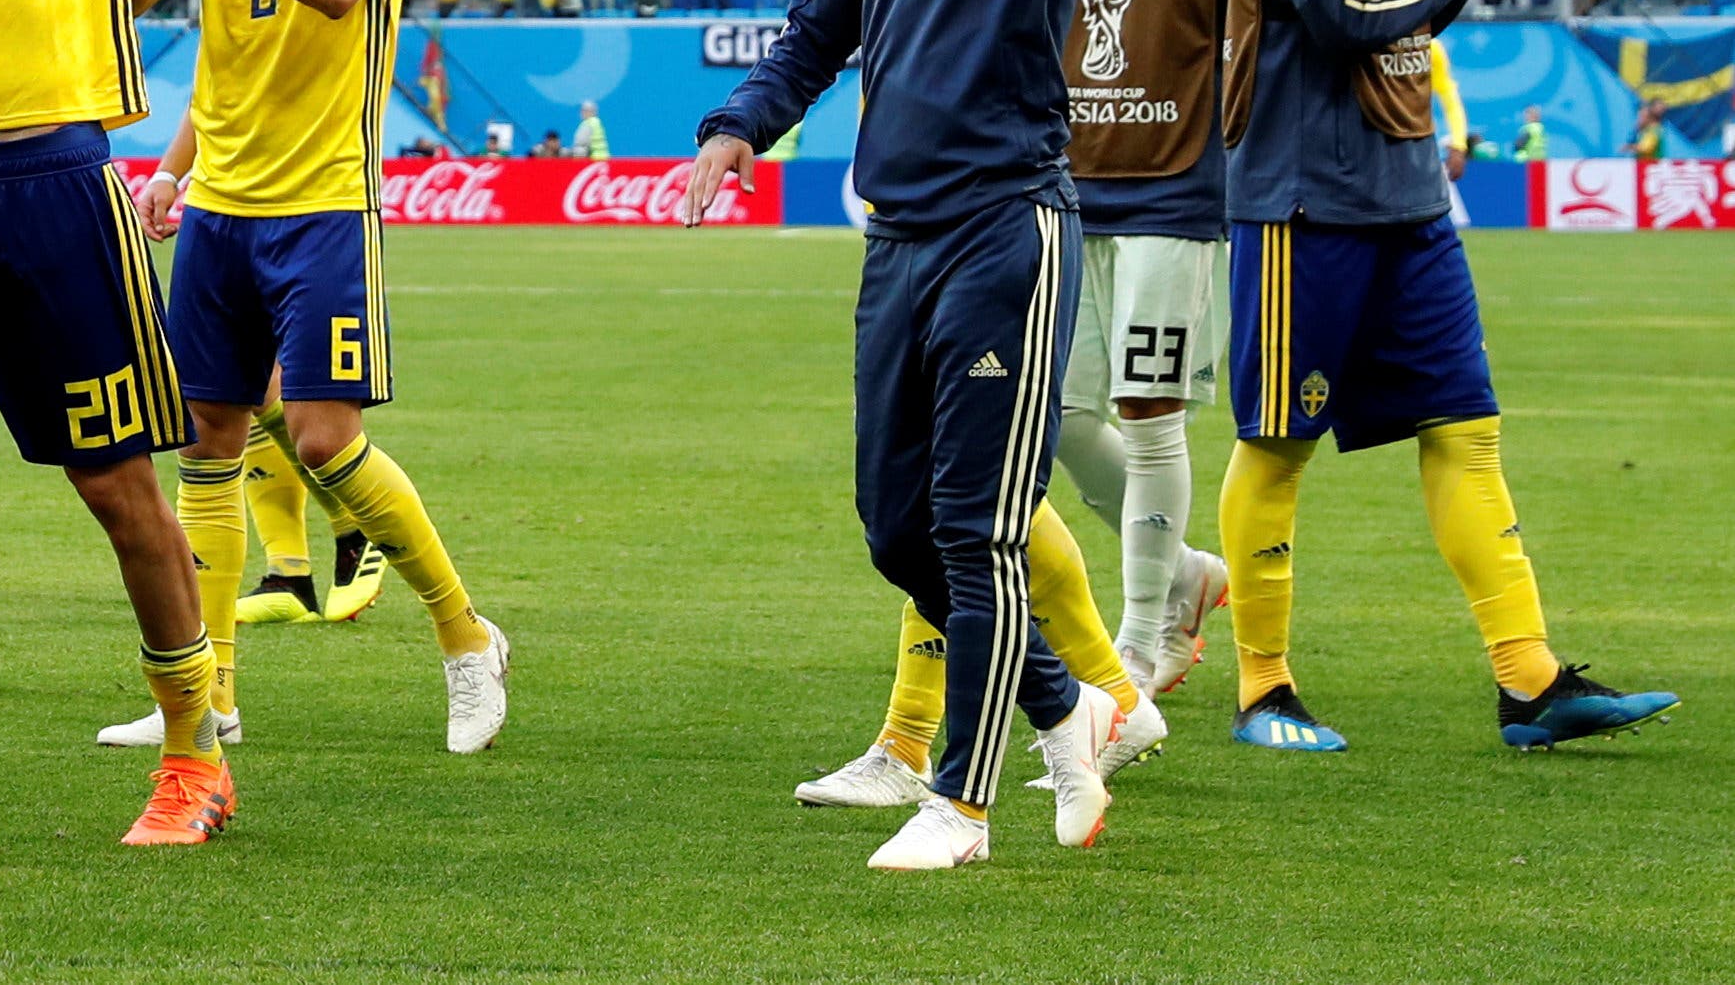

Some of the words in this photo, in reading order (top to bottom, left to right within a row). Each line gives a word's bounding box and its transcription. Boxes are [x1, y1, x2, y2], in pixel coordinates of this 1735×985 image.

[1069, 101, 1117, 124] SSIA
[1118, 100, 1179, 123] 2018
[1082, 87, 1122, 99] WORLD
[1122, 87, 1146, 99] CUP
[562, 161, 741, 222] Coca-Ca
[330, 317, 363, 381] 6
[1124, 325, 1188, 384] 23
[968, 366, 1008, 377] adidas
[64, 363, 145, 449] 20
[907, 647, 946, 660] adida
